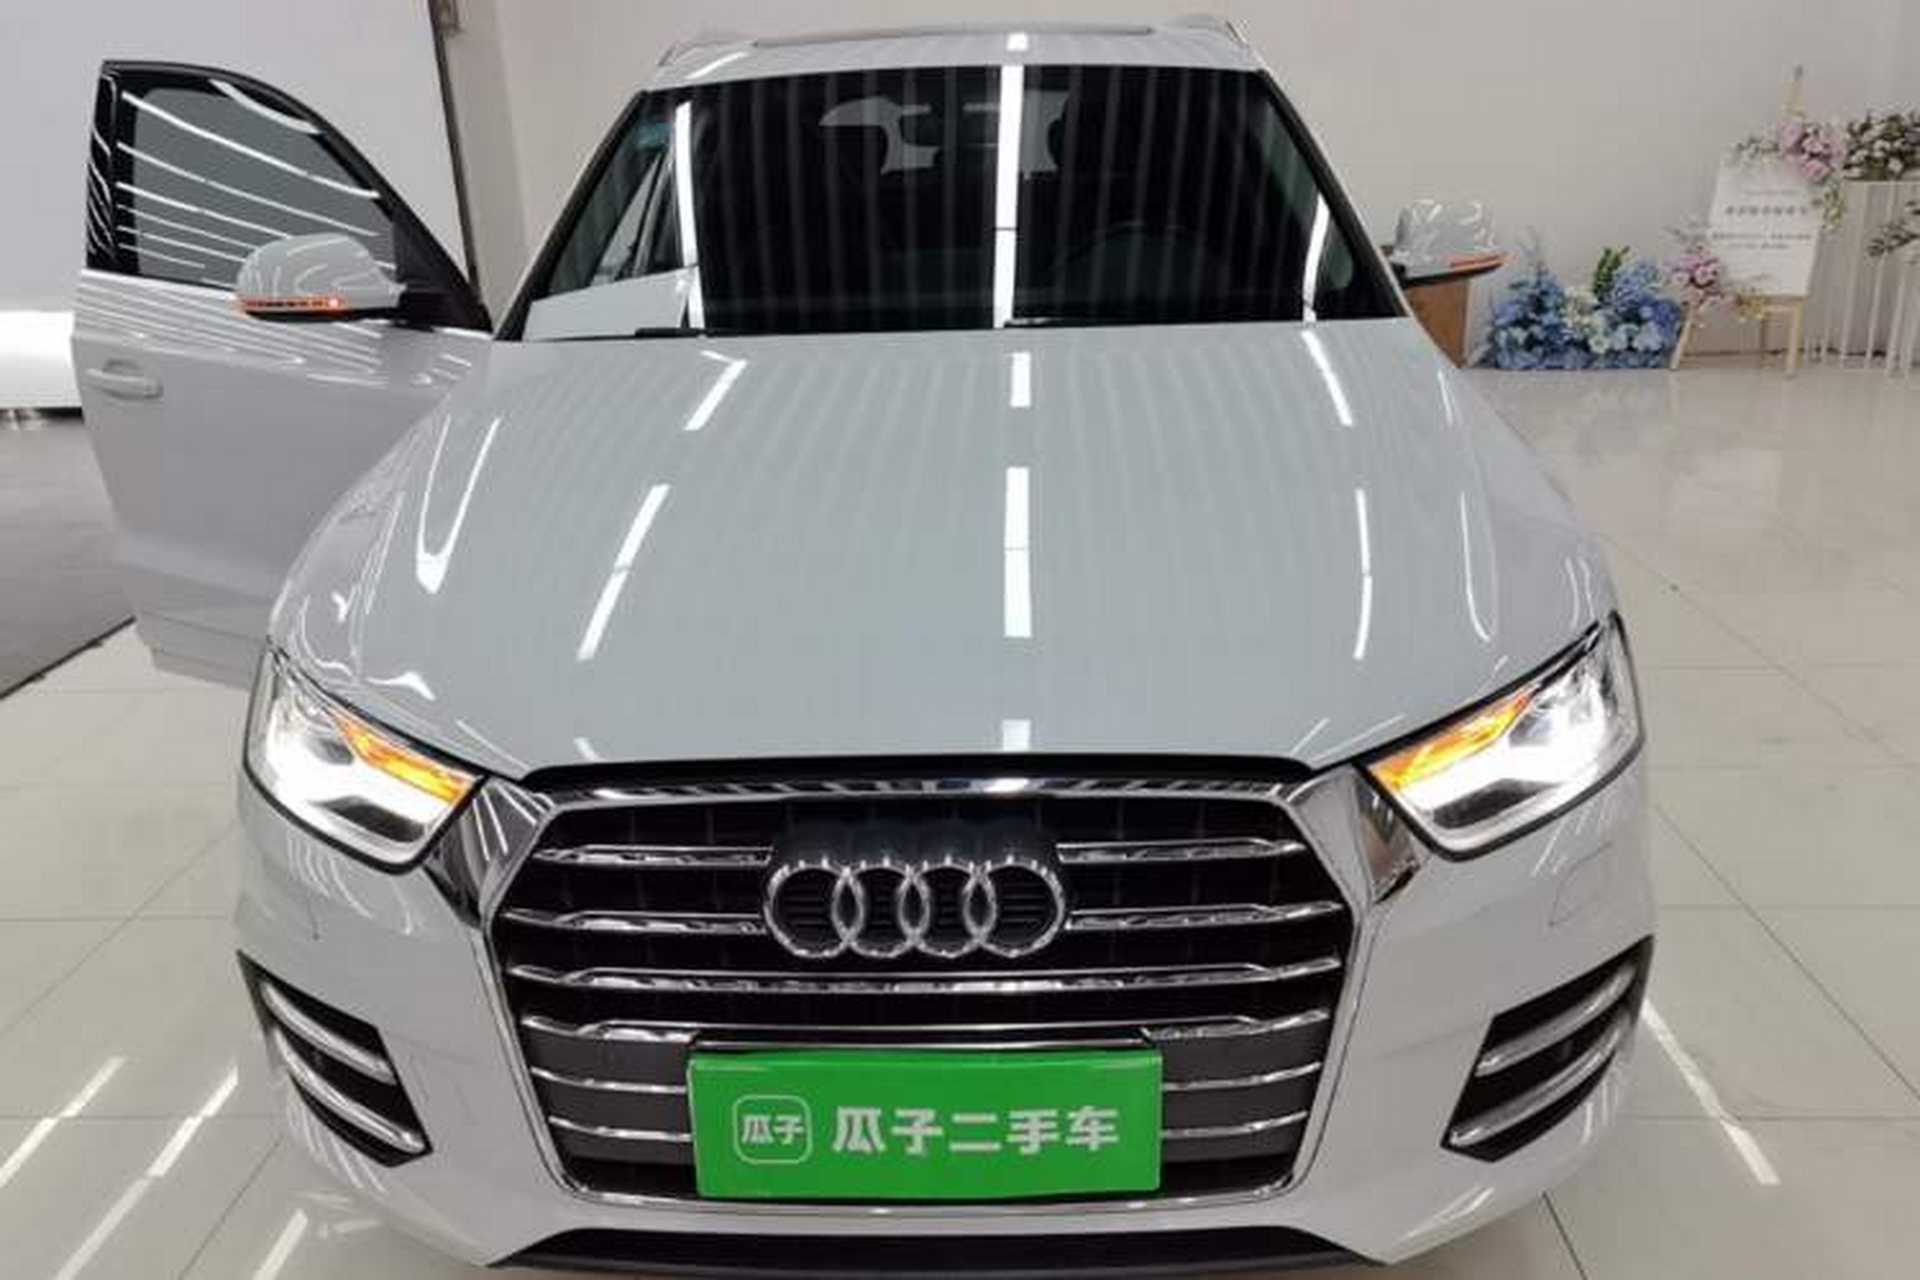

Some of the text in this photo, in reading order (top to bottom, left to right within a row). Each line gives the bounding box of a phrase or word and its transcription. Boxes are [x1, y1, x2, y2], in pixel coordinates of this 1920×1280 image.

[740, 1115, 804, 1145] 瓜子
[832, 1106, 1120, 1156] 瓜子二手车
